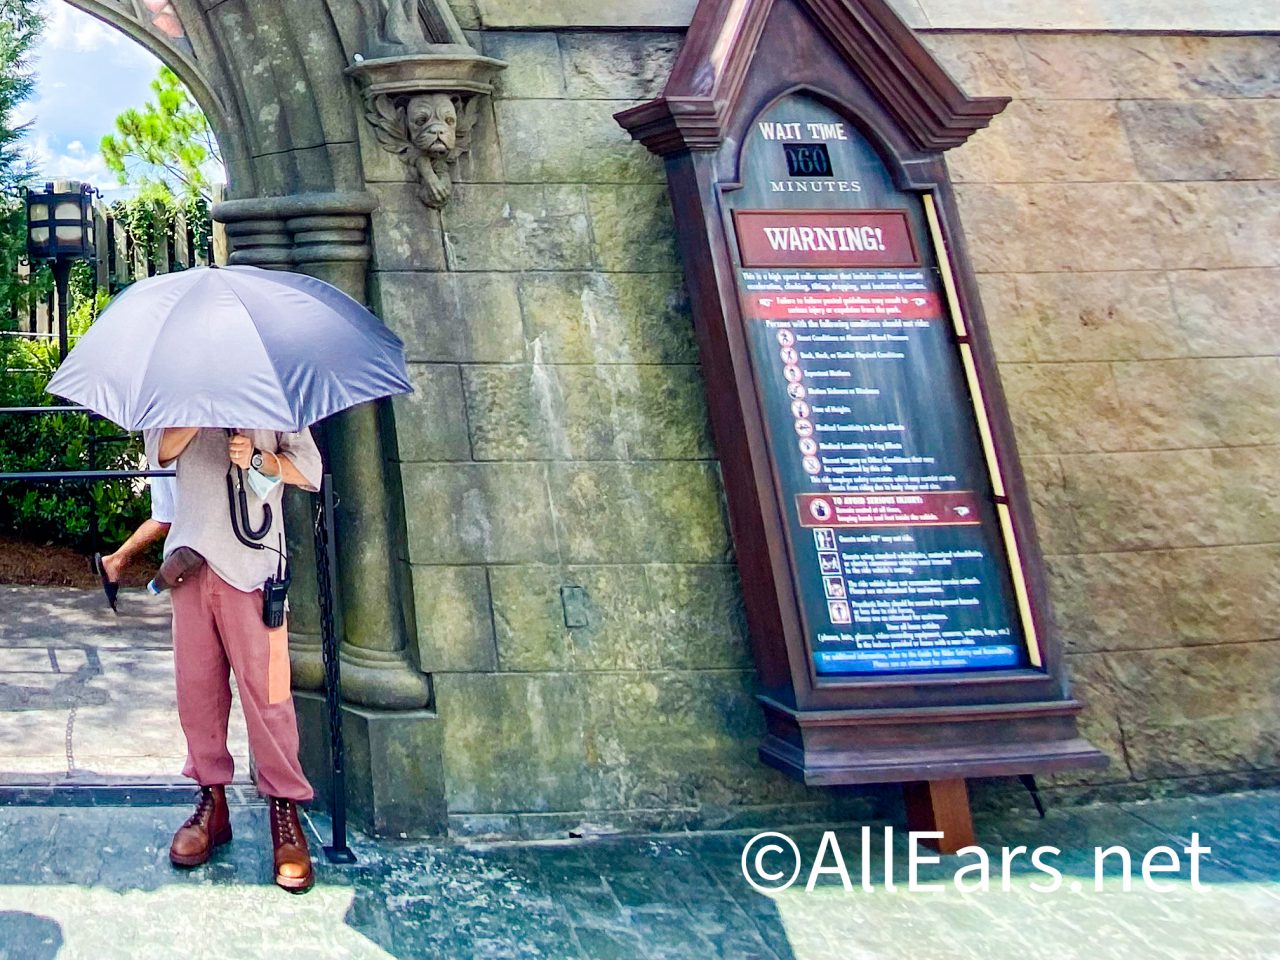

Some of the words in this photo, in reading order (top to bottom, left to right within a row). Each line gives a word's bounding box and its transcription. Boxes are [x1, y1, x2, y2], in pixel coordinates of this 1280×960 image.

[759, 122, 802, 140] WAIT
[807, 122, 848, 141] TIME
[770, 180, 862, 192] MINUTES
[763, 226, 886, 252] WARNING!
